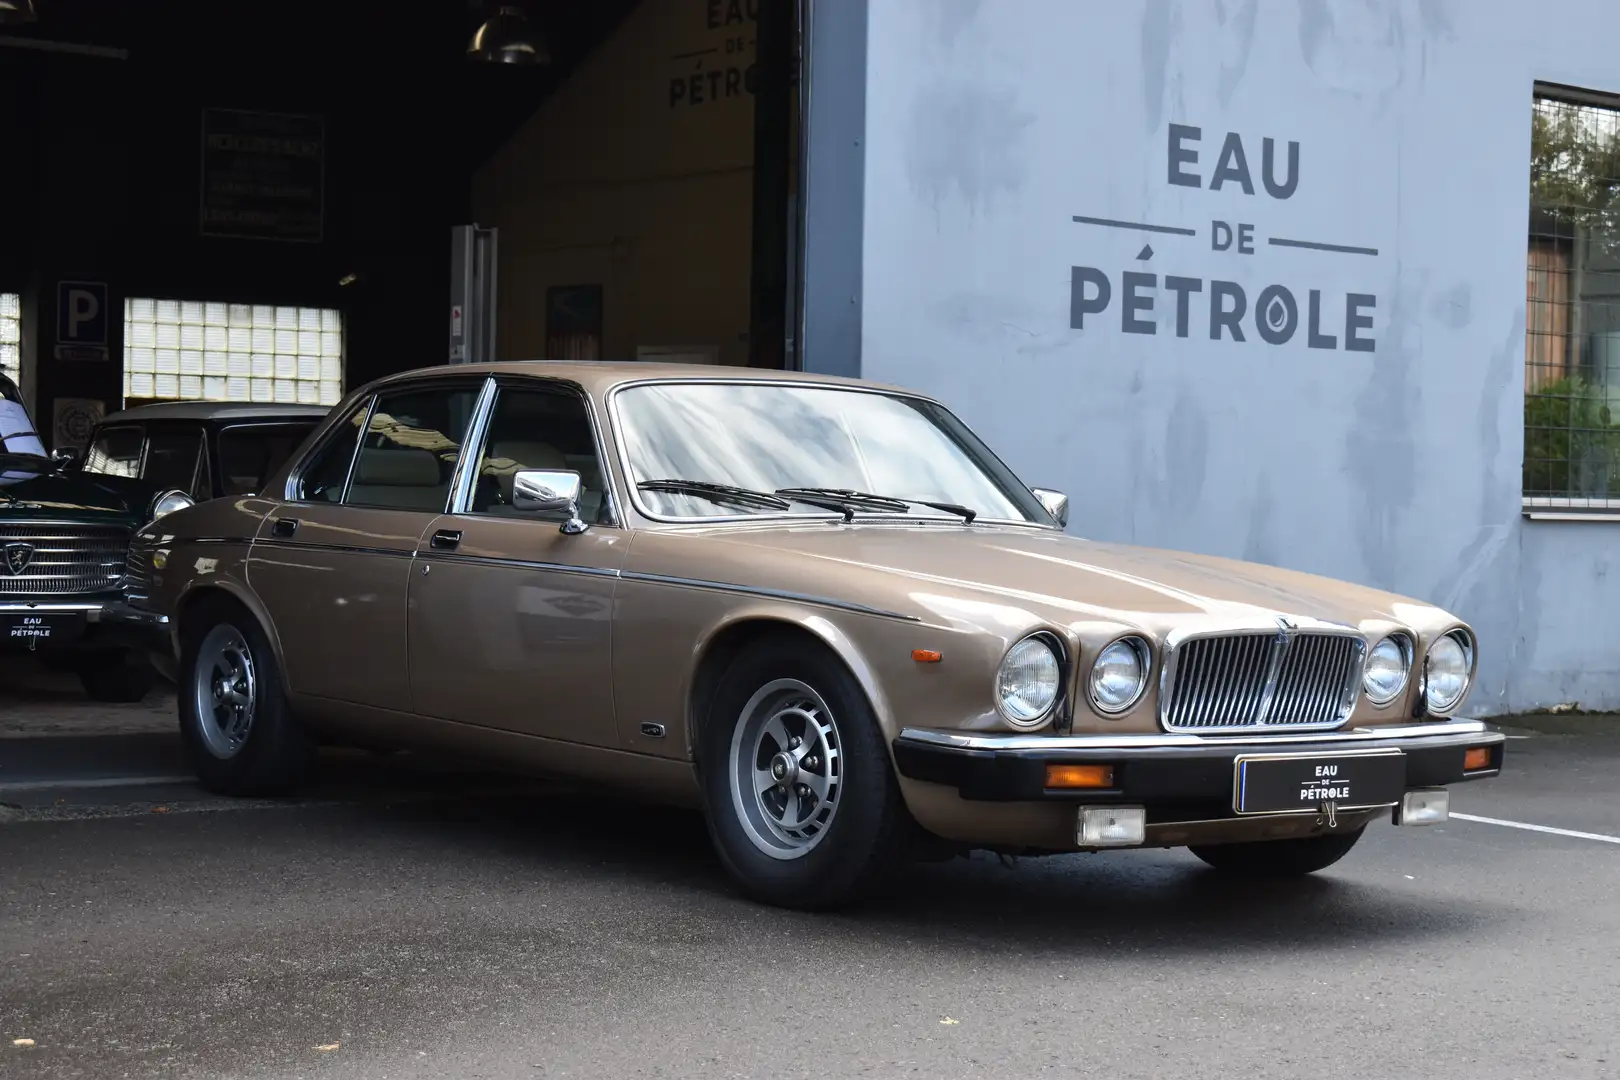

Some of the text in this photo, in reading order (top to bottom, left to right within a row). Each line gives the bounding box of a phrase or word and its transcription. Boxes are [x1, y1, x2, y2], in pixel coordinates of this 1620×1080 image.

[726, 36, 746, 54] DE
[669, 58, 799, 109] PÉTRO
[1168, 123, 1300, 200] EAU
[1211, 220, 1255, 255] DE
[68, 289, 99, 338] P
[1070, 243, 1377, 352] PÉTROLE
[23, 617, 42, 625] EAU
[1315, 765, 1338, 777] EAU
[1300, 785, 1350, 800] PÉTROLE
